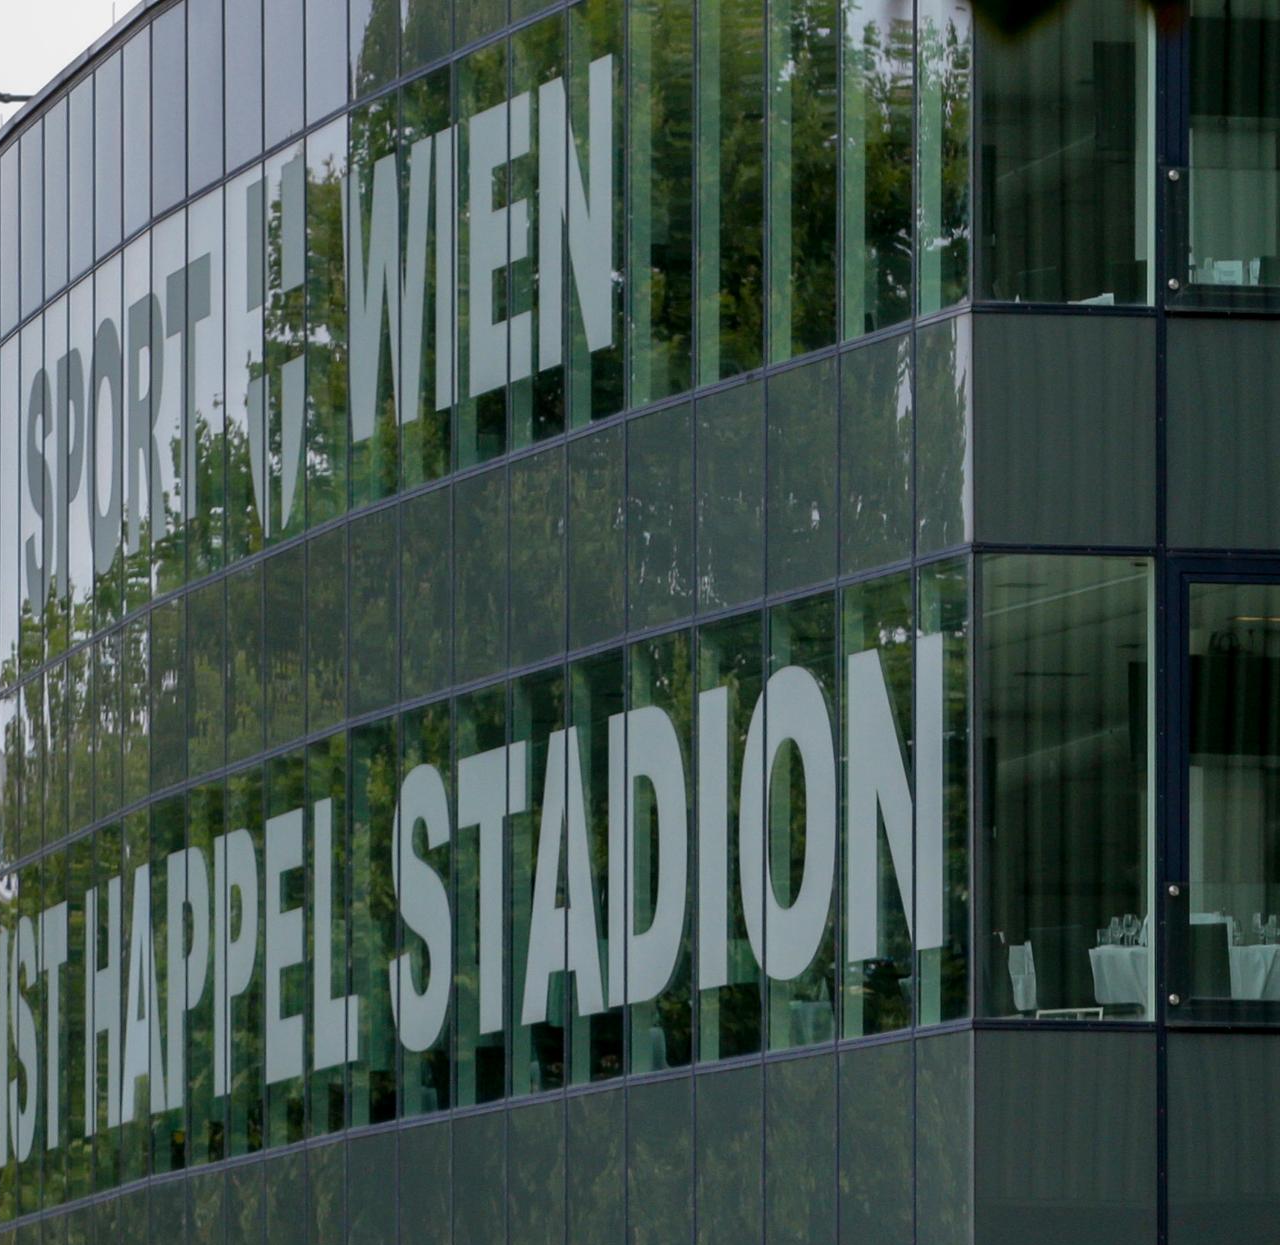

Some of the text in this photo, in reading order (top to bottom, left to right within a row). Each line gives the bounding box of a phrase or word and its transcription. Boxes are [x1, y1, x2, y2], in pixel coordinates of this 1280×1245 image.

[25, 53, 613, 618] SPORT WIEN
[84, 798, 359, 1138] HAPPEL
[389, 633, 944, 1054] STADION
